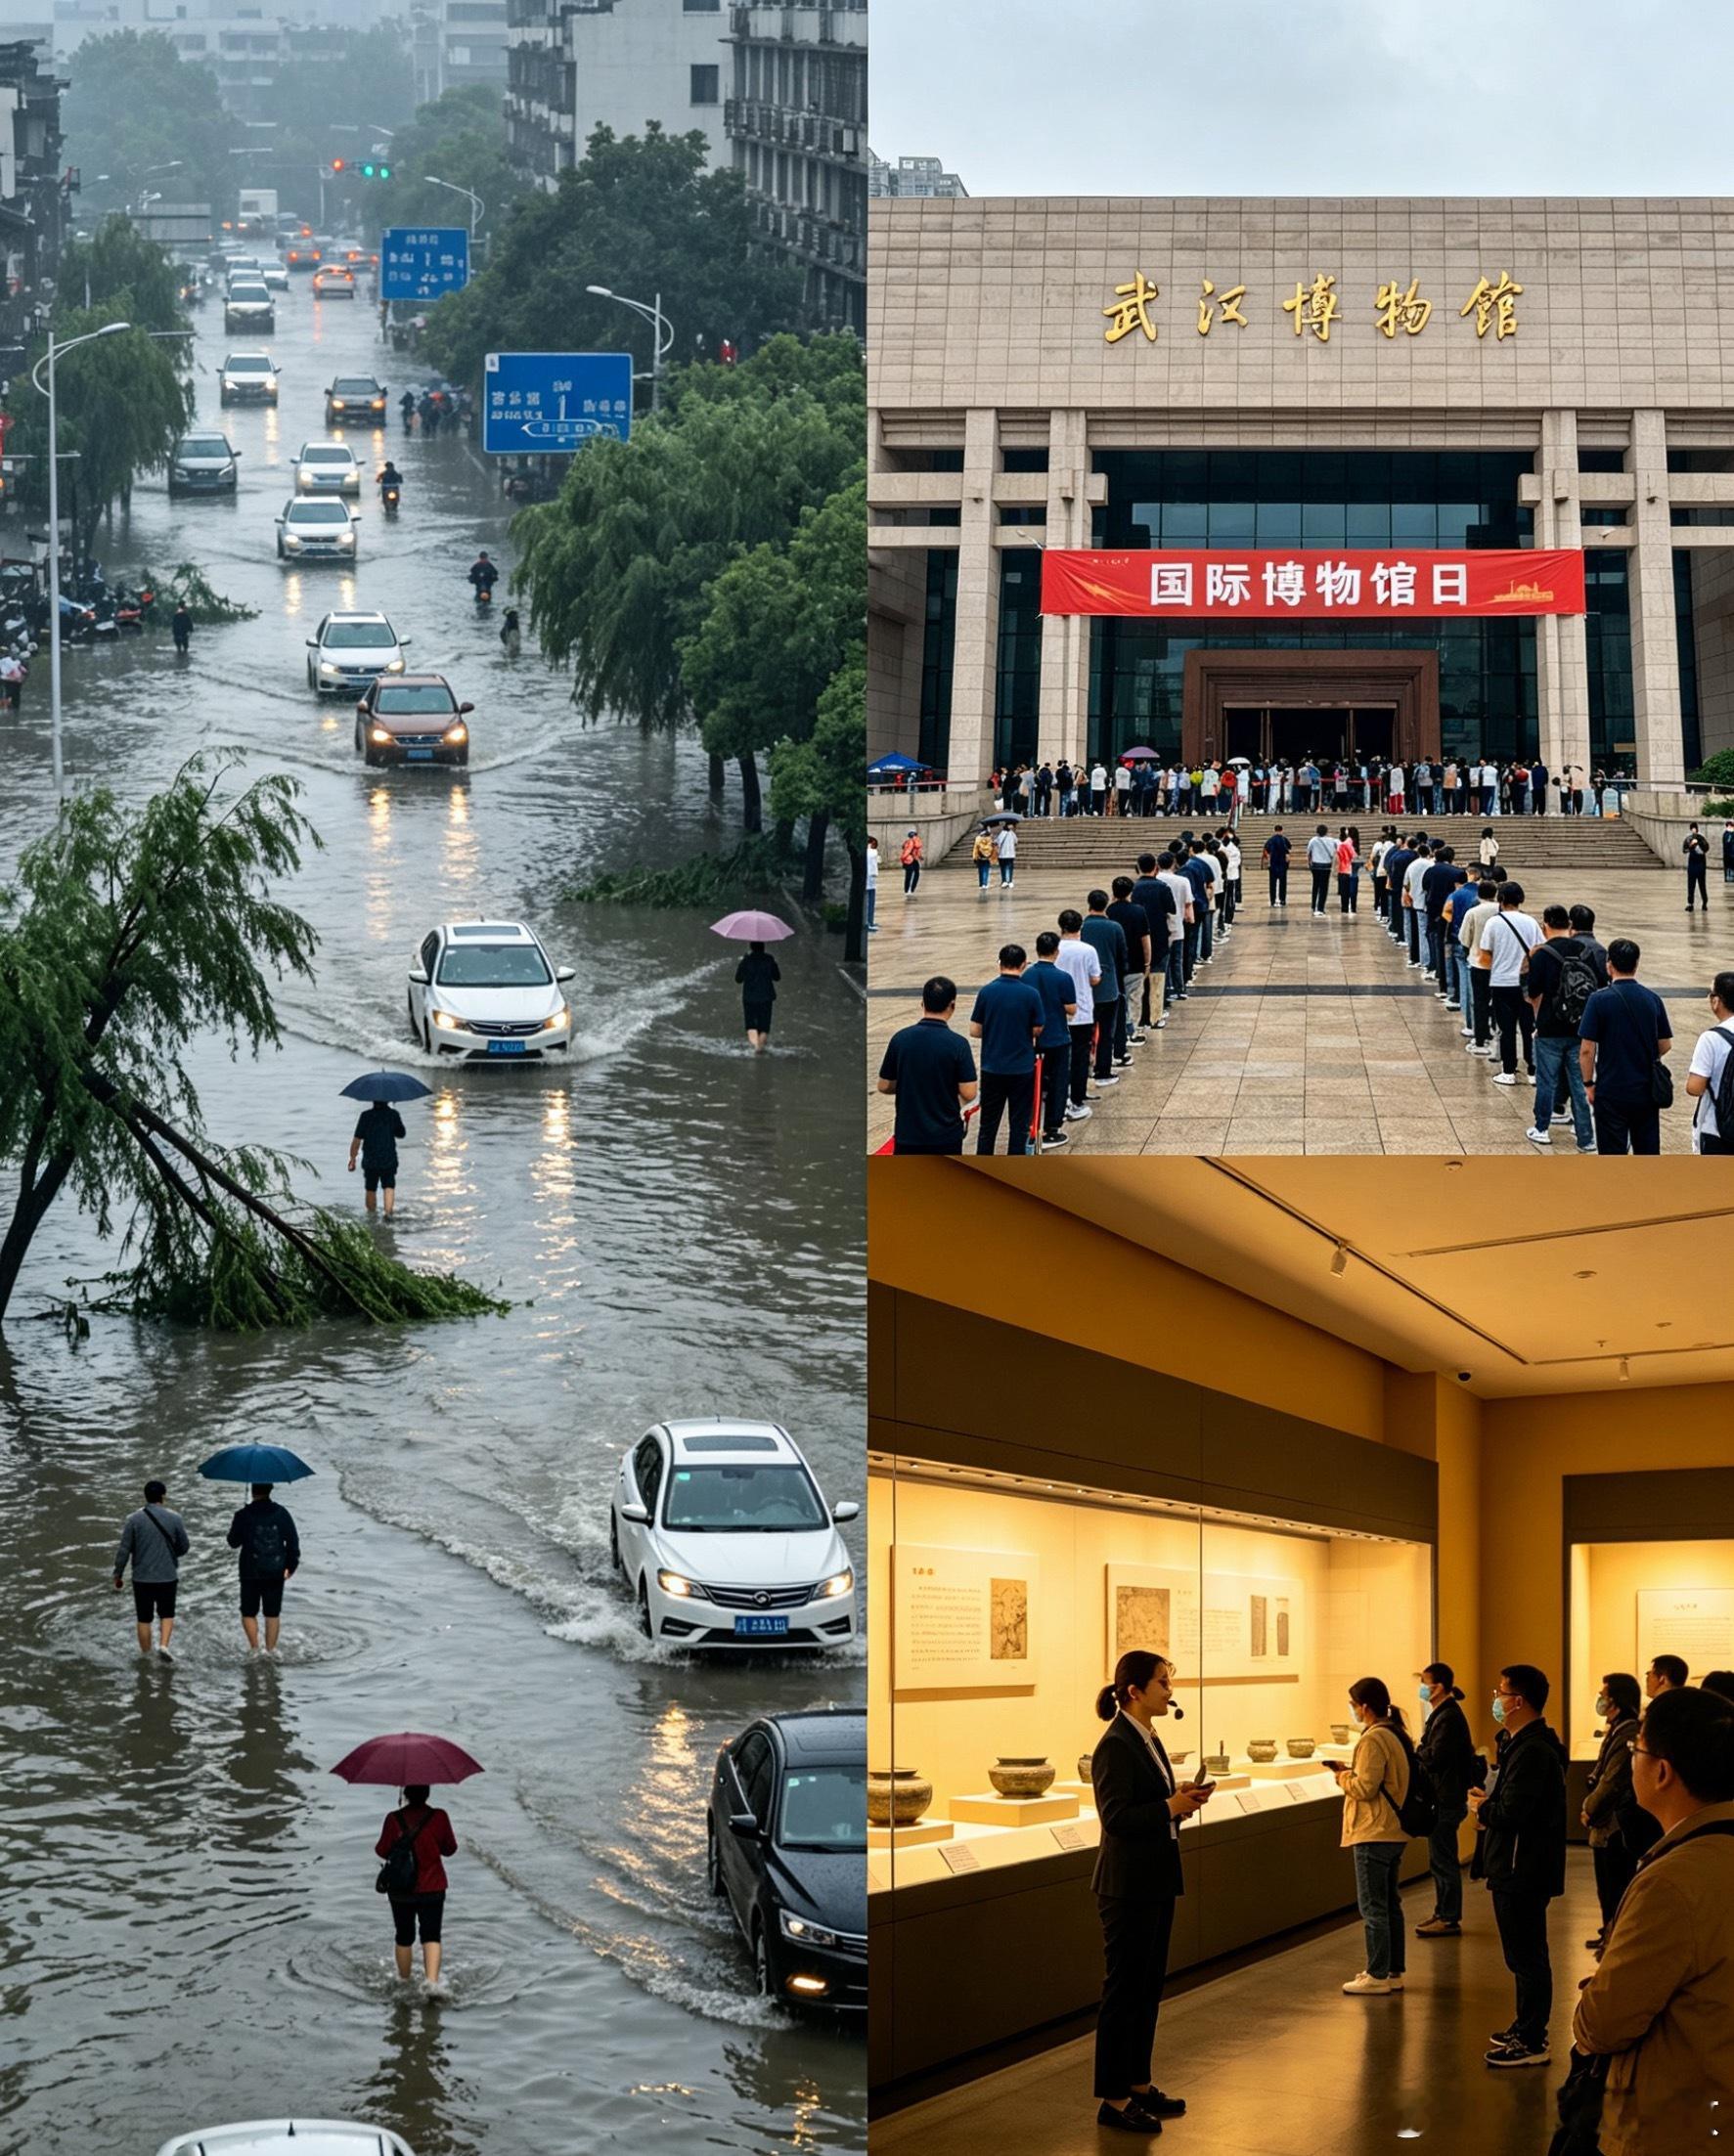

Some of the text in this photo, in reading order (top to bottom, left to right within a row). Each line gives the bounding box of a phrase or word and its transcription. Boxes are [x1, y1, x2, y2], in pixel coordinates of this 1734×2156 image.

[1102, 270, 1524, 342] 武汉博物馆
[1150, 562, 1467, 607] 国际博物馆日
